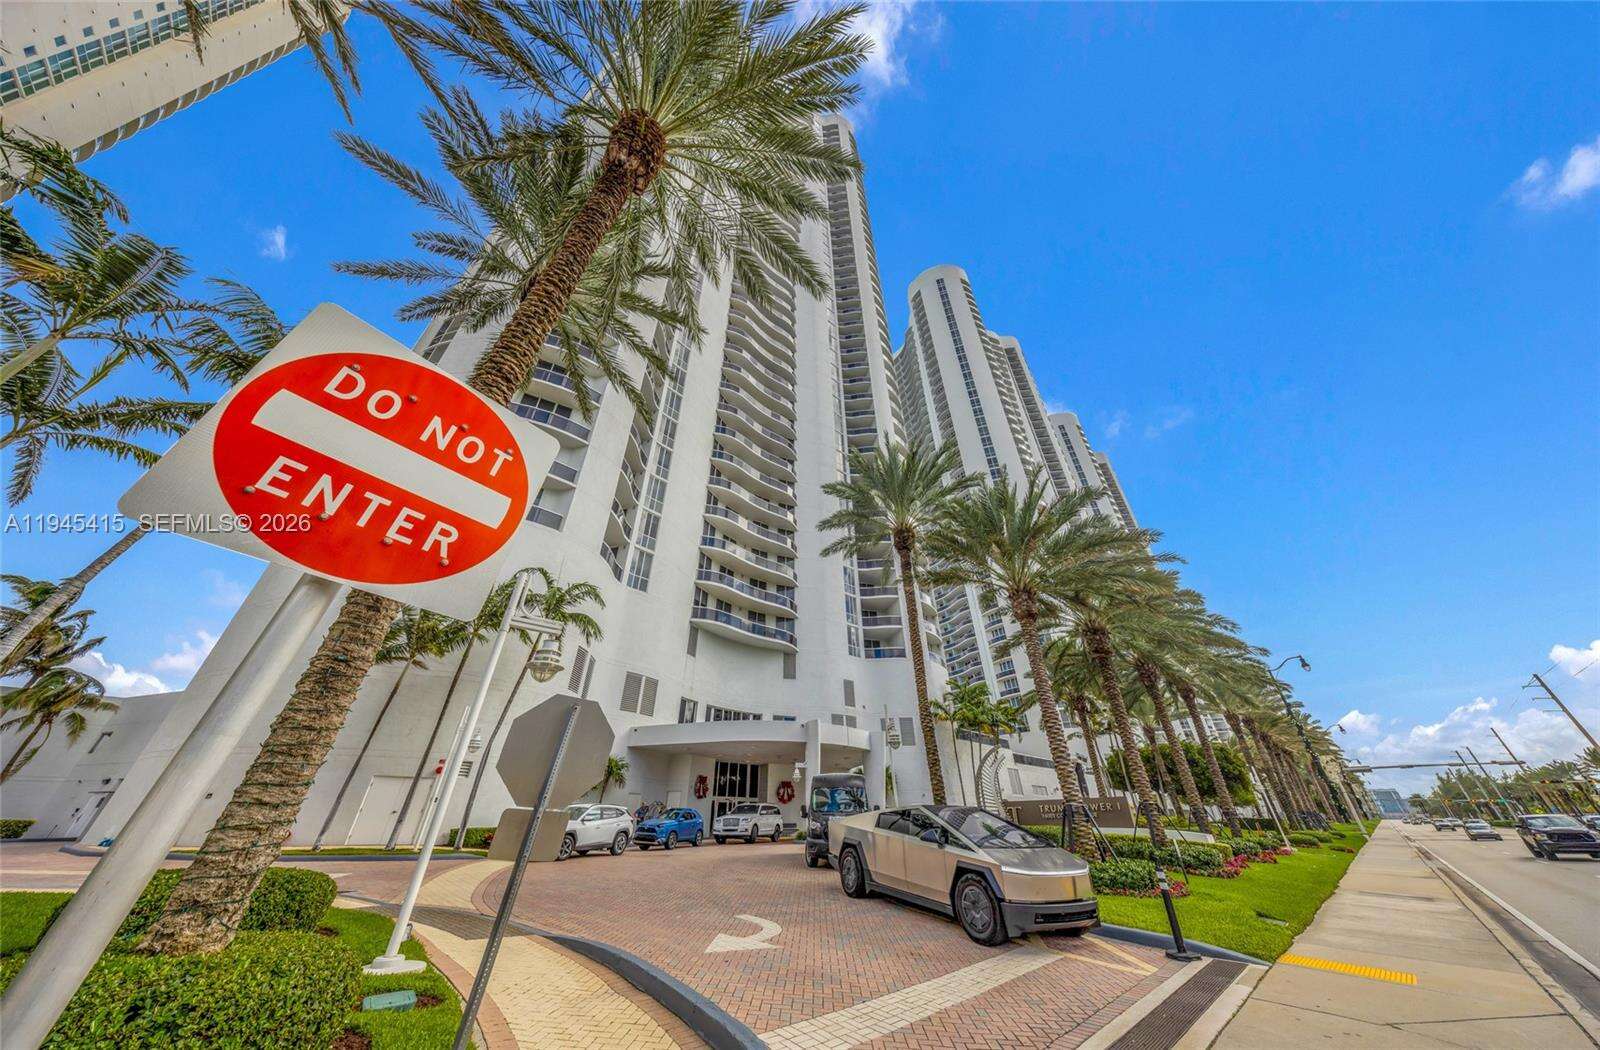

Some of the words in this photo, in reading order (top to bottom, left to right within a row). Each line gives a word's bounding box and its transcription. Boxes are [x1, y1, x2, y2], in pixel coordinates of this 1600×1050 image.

[323, 366, 402, 420] DO
[419, 415, 513, 477] NOT
[254, 455, 459, 559] ENTER
[1088, 802, 1113, 811] WER
